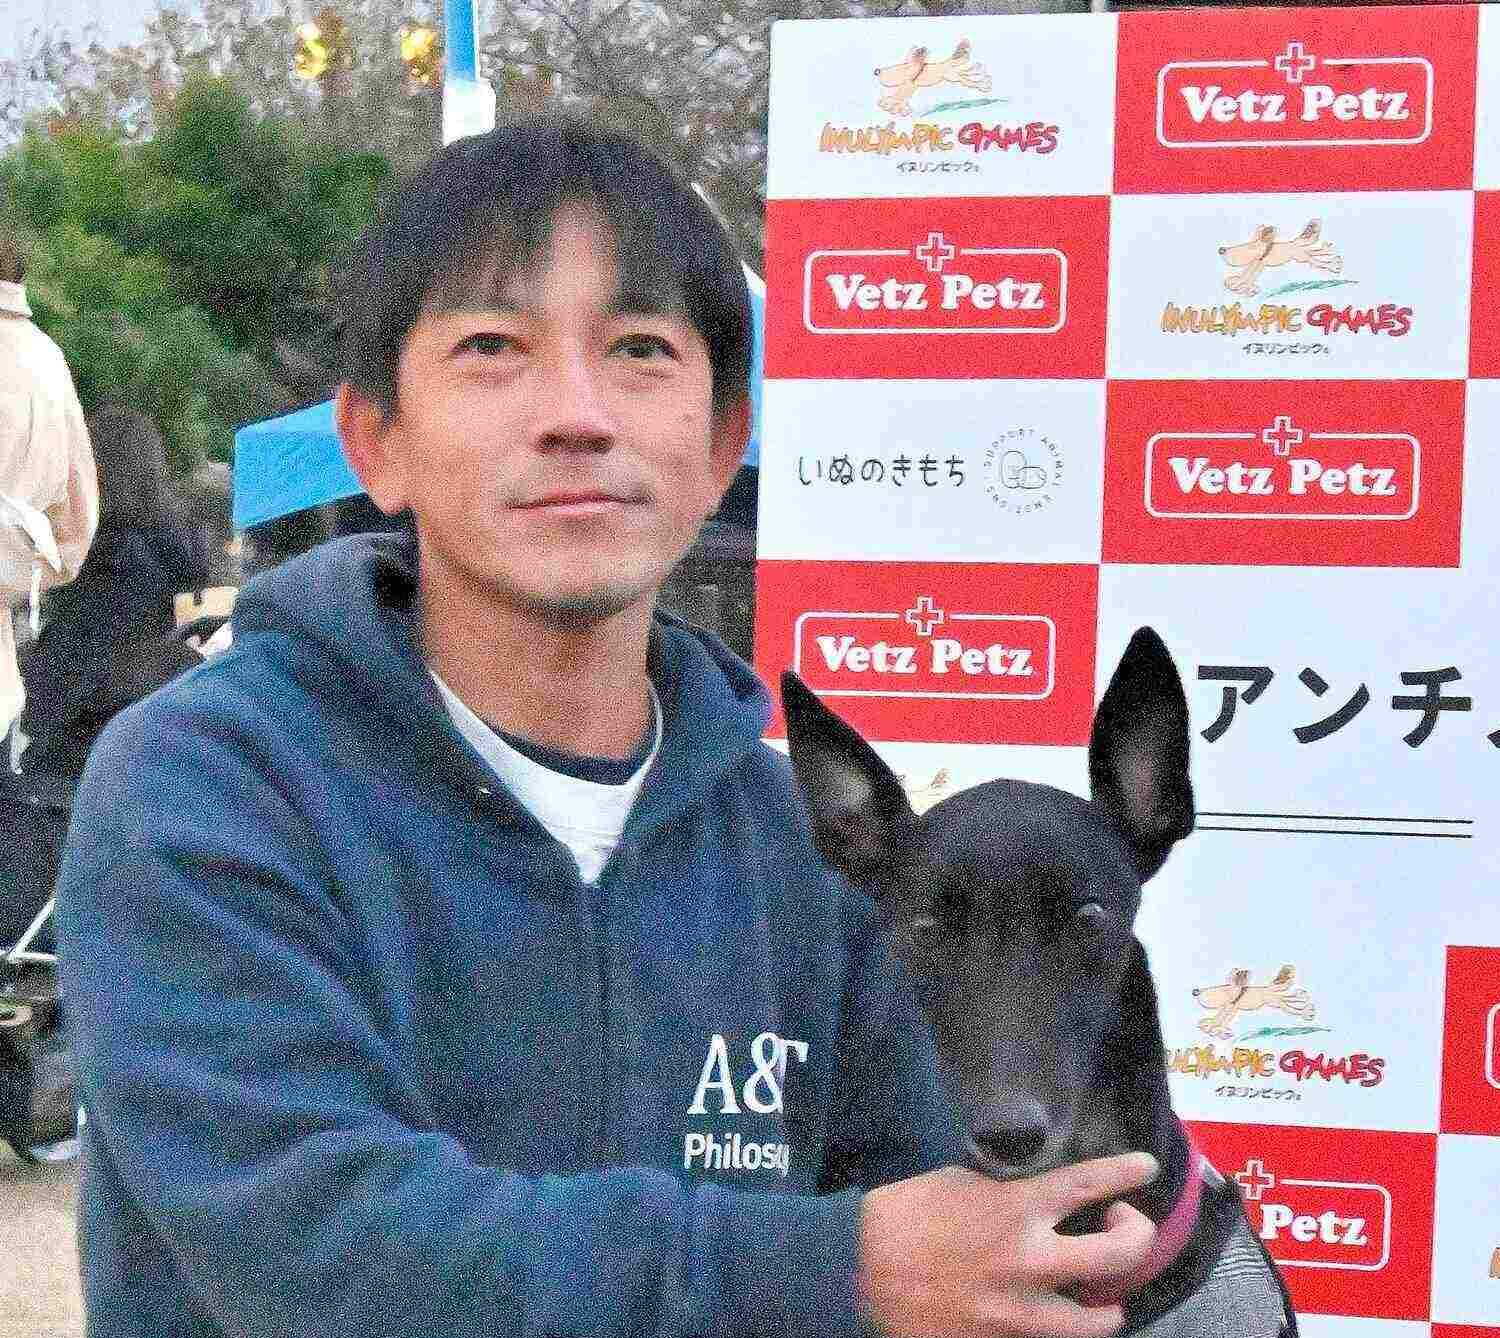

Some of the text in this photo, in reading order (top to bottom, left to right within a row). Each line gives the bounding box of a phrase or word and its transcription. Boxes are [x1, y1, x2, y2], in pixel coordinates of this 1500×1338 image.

[1181, 86, 1409, 122] Vetz Petz
[958, 122, 1059, 154] GAMES
[827, 273, 1044, 310] Vetz Petz
[1306, 303, 1413, 337] GAMES
[799, 455, 965, 488] いぬのきもち
[1169, 457, 1396, 496] Vetz Petz
[817, 637, 1033, 677] Vetz Petz
[1278, 1049, 1385, 1088] GAMES
[1260, 1203, 1367, 1247] Petz
